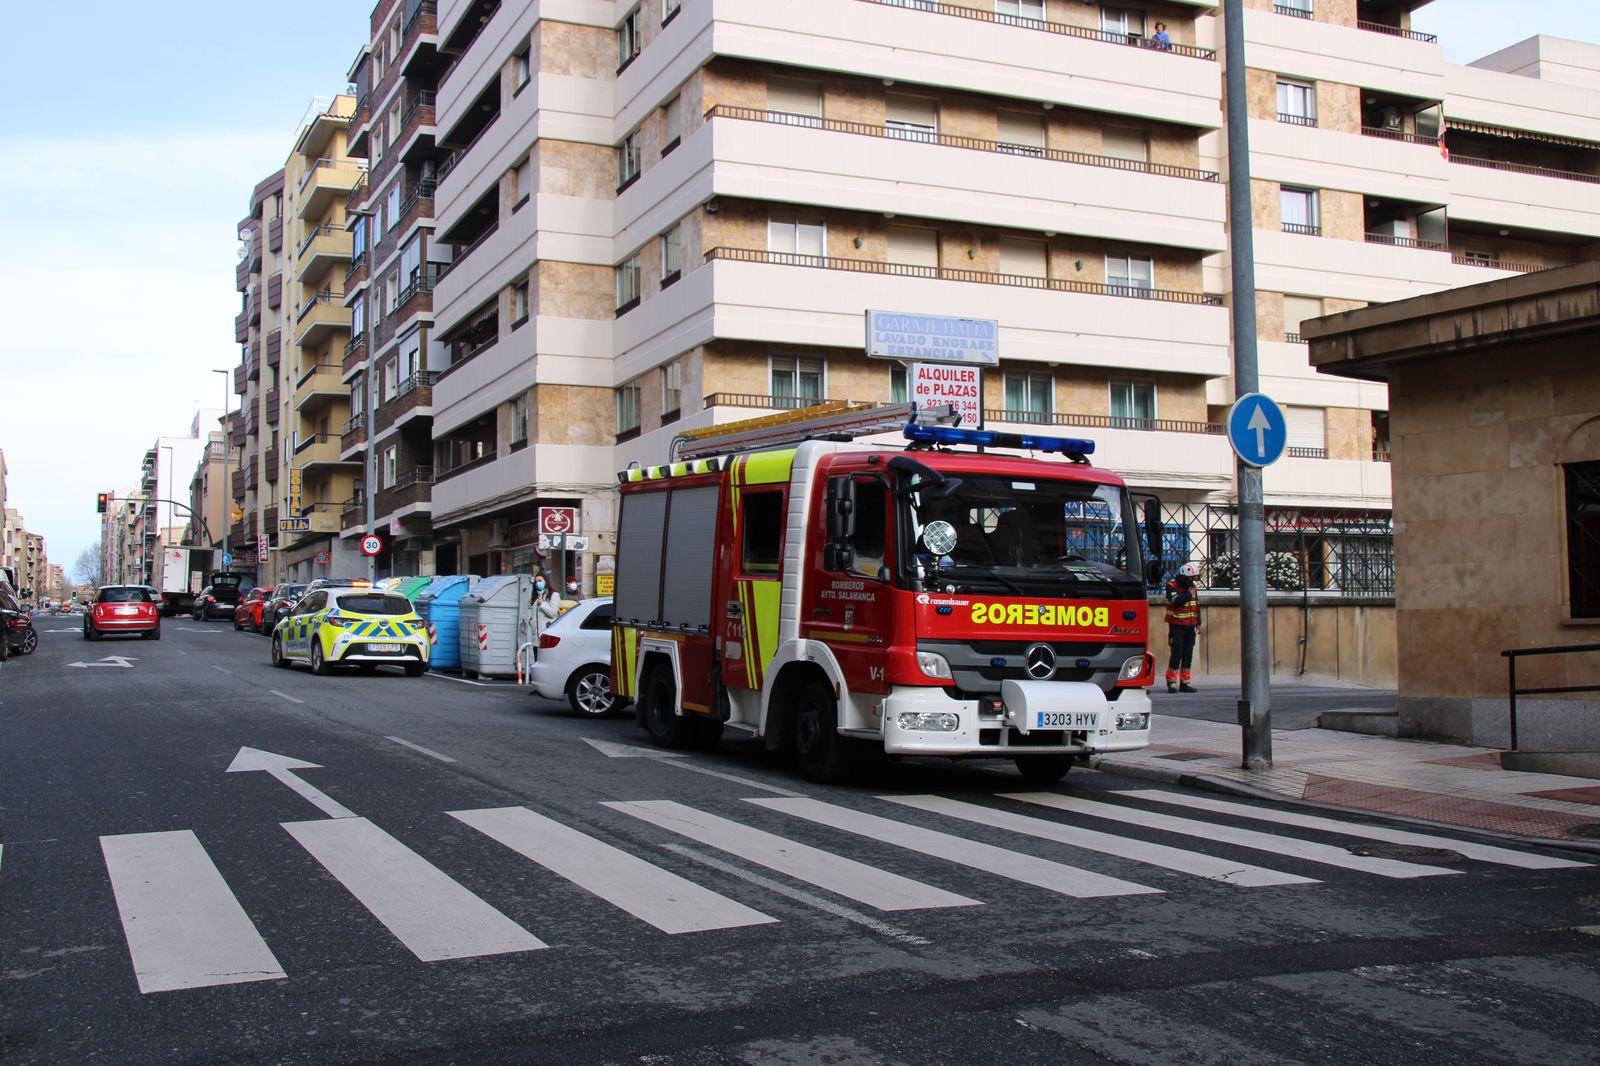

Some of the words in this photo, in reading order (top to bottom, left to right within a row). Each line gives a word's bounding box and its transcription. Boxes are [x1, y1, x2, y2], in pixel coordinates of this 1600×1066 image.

[875, 333, 926, 345] LAVADO
[932, 336, 994, 350] ENGRASE
[887, 345, 965, 359] ESTANCIAS
[918, 367, 975, 383] ALQUILER
[916, 383, 930, 395] de
[933, 383, 977, 397] PLAZAS
[962, 401, 977, 412] 344
[962, 413, 977, 423] 150
[290, 469, 301, 517] HOSTAL
[260, 534, 268, 561] BAZAR
[365, 541, 378, 549] 30
[831, 580, 865, 590] BOMBEROS
[838, 591, 876, 602] SALAMANCA
[930, 598, 970, 606] rosenbauer
[1044, 713, 1072, 726] 3203
[1075, 713, 1097, 726] HYV
